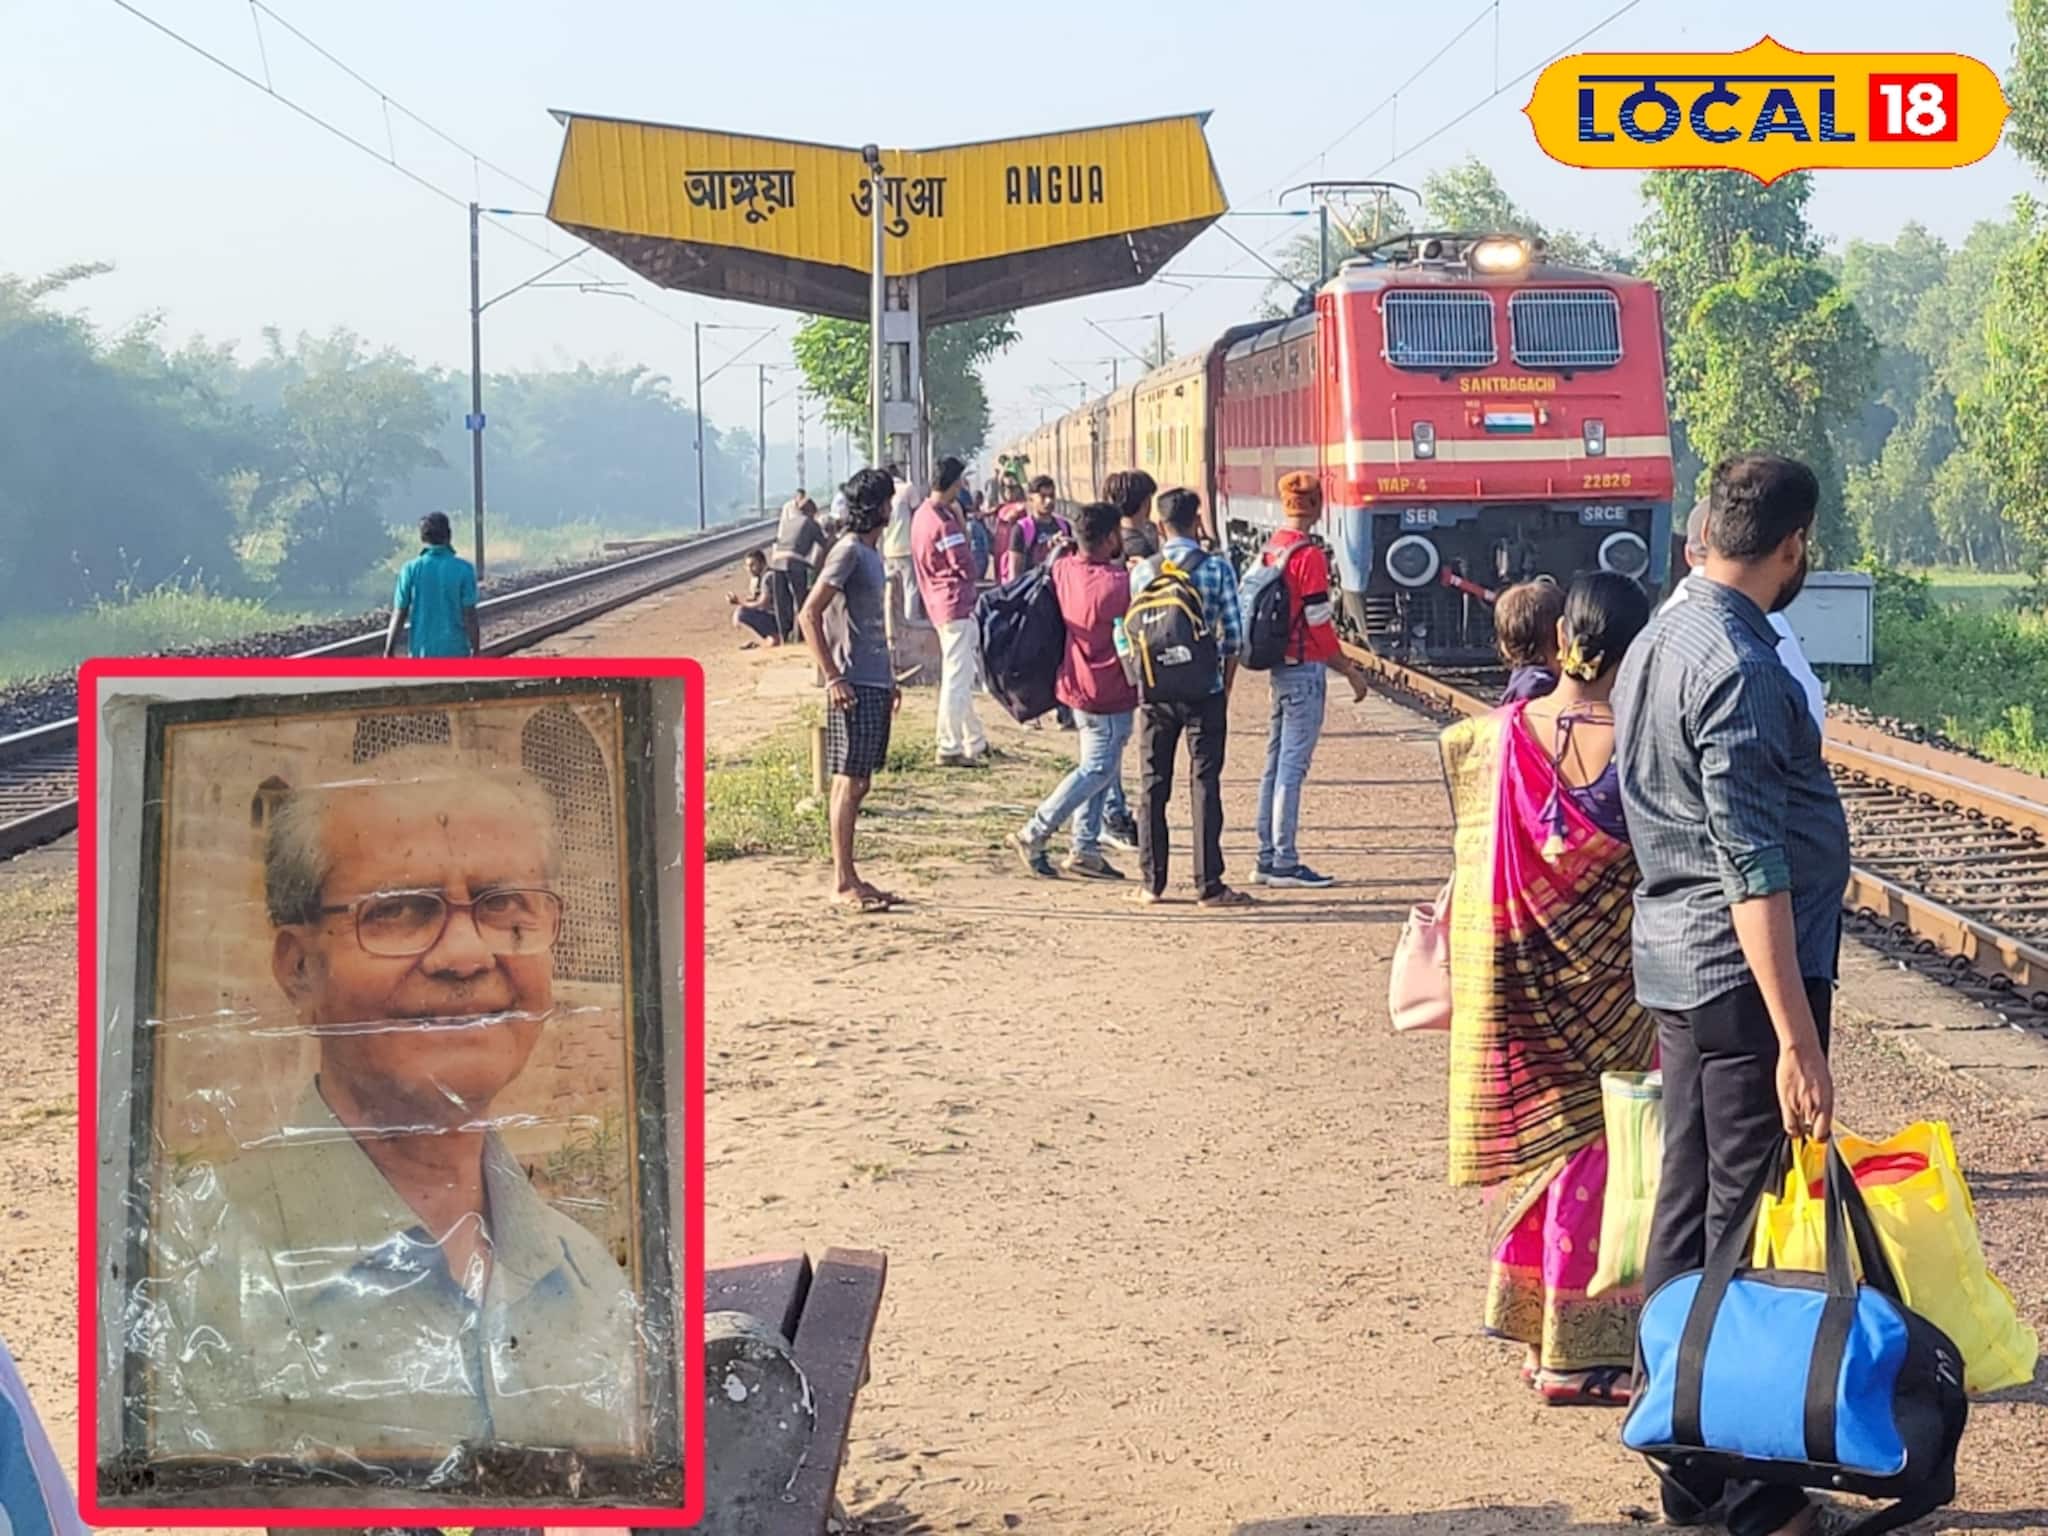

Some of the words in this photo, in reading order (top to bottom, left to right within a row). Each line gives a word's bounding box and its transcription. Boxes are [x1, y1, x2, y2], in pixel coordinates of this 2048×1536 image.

[1005, 165, 1104, 205] ANGUA
[1460, 376, 1557, 393] SANTRAGACHI
[1405, 508, 1438, 524] SER
[1583, 506, 1625, 520] SRCE
